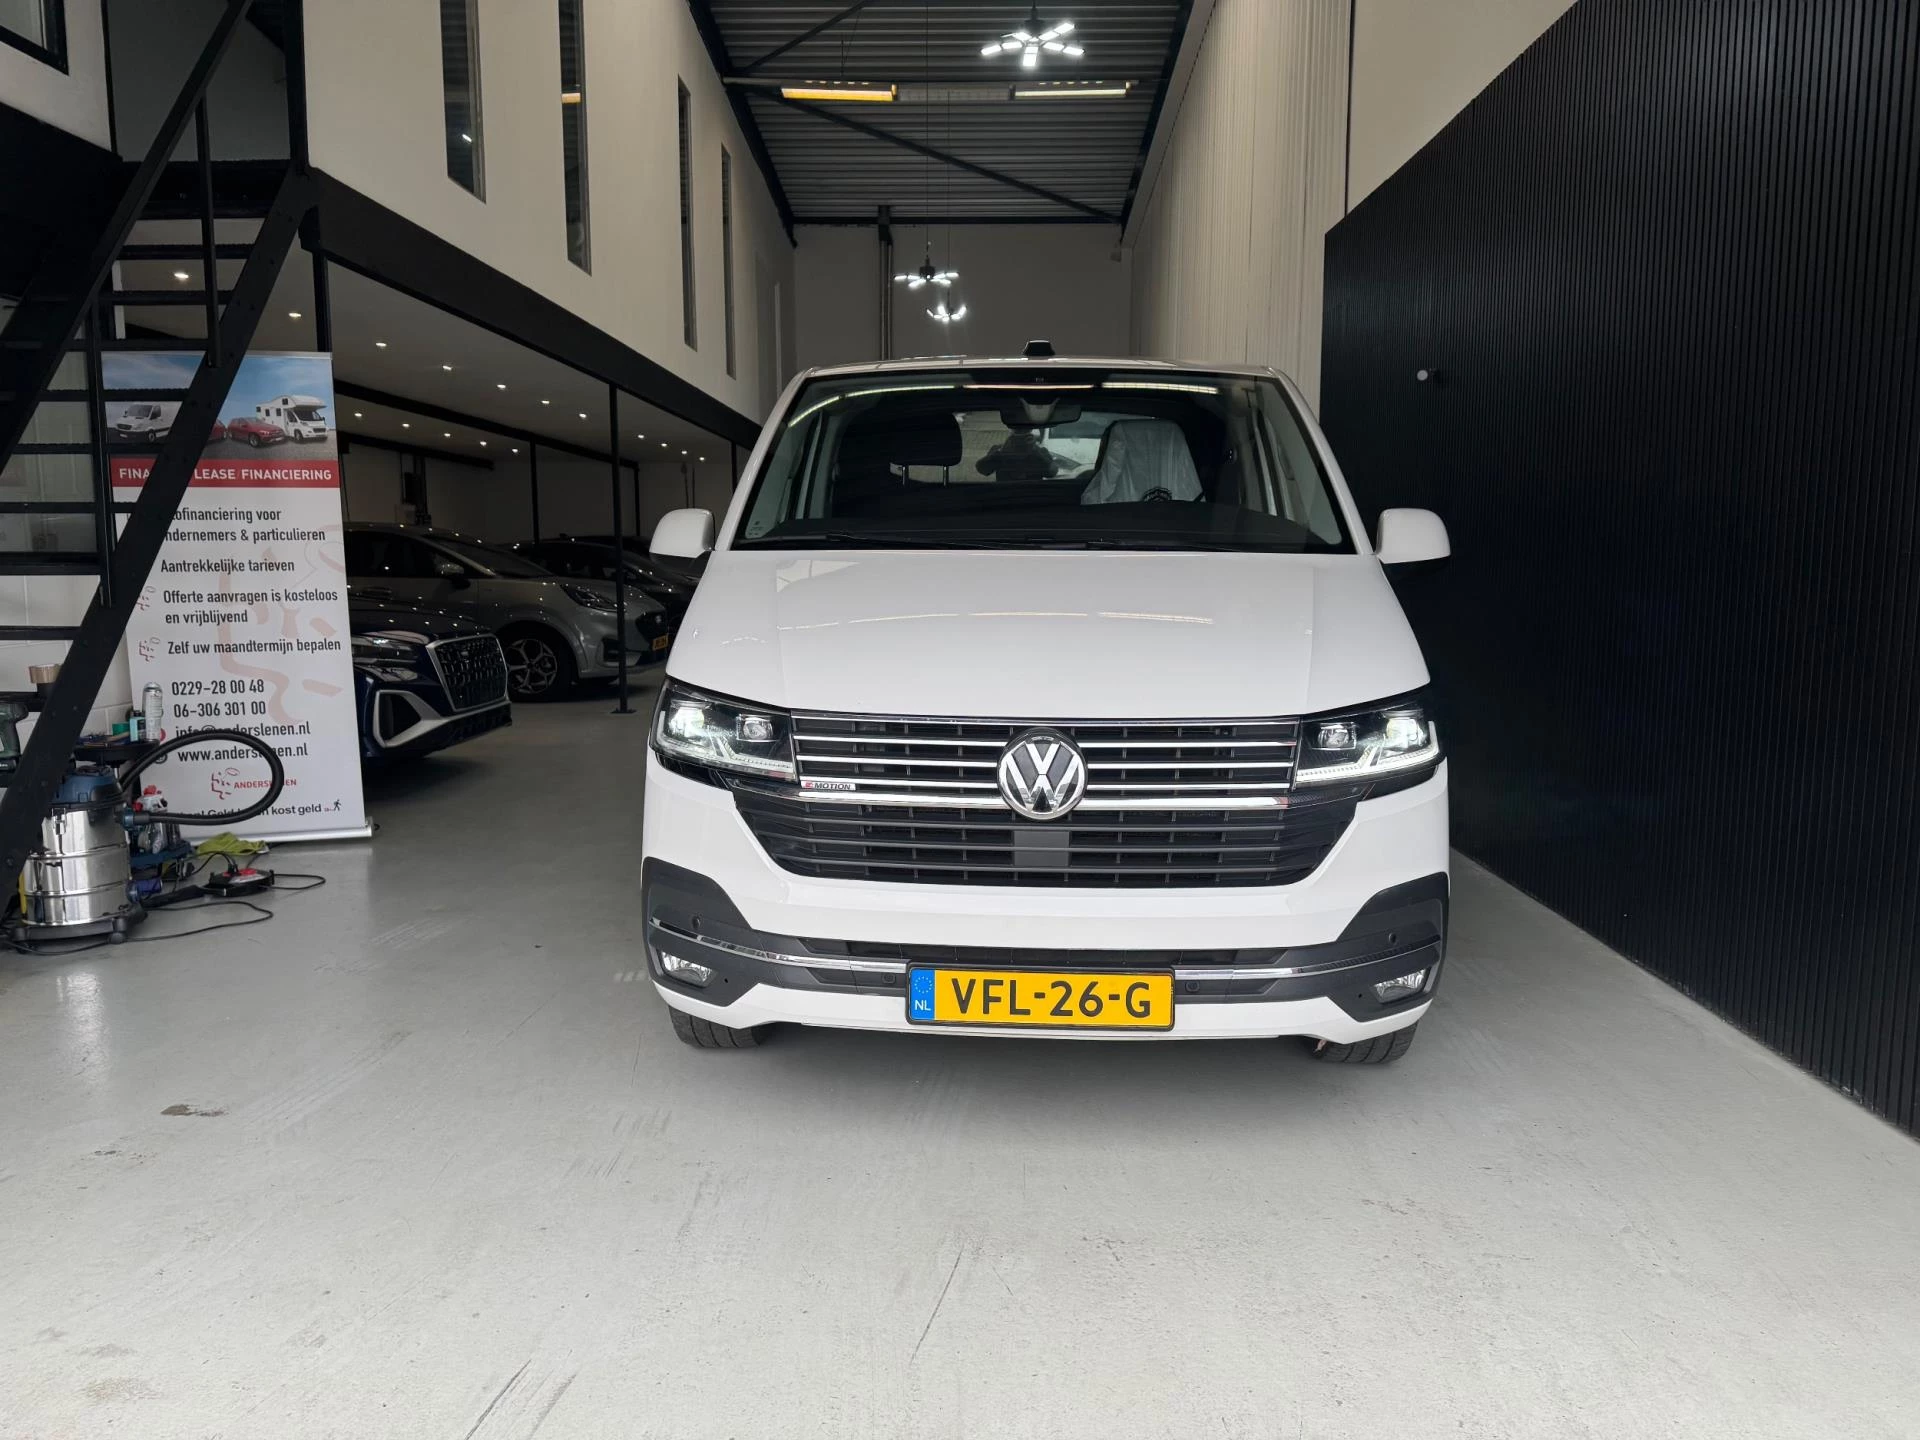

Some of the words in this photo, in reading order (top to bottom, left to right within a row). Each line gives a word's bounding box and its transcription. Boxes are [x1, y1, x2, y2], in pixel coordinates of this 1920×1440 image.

[194, 467, 236, 480] LEASE
[241, 468, 332, 481] FINANCIERING
[172, 507, 253, 523] ofinanciering
[256, 510, 282, 521] voor
[165, 528, 237, 542] ndernemers
[240, 529, 250, 541] &
[253, 529, 326, 544] particulieren
[160, 559, 245, 575] Aantrekkelijke
[248, 560, 295, 572] tarieven
[163, 590, 203, 604] Offerte
[207, 591, 268, 605] aanvragen
[271, 589, 281, 601] is
[284, 589, 338, 601] kosteloos
[165, 613, 180, 624] en
[183, 609, 248, 626] vrijblijvend
[168, 641, 190, 654] Zelf
[193, 643, 211, 654] uw
[214, 639, 293, 655] maandtermijn
[296, 638, 341, 653] bepalen
[172, 681, 226, 696] 0229-28
[230, 680, 246, 694] 00
[249, 679, 265, 693] 48
[173, 703, 221, 718] 06-306
[225, 701, 246, 716] 301
[251, 701, 266, 715] 00
[178, 742, 308, 762] www.andersen.nl
[233, 779, 297, 790] ANDERSEN
[271, 806, 296, 815] kost
[297, 804, 322, 815] geld
[914, 999, 931, 1012] NL
[951, 978, 1150, 1018] VFL-26-G
